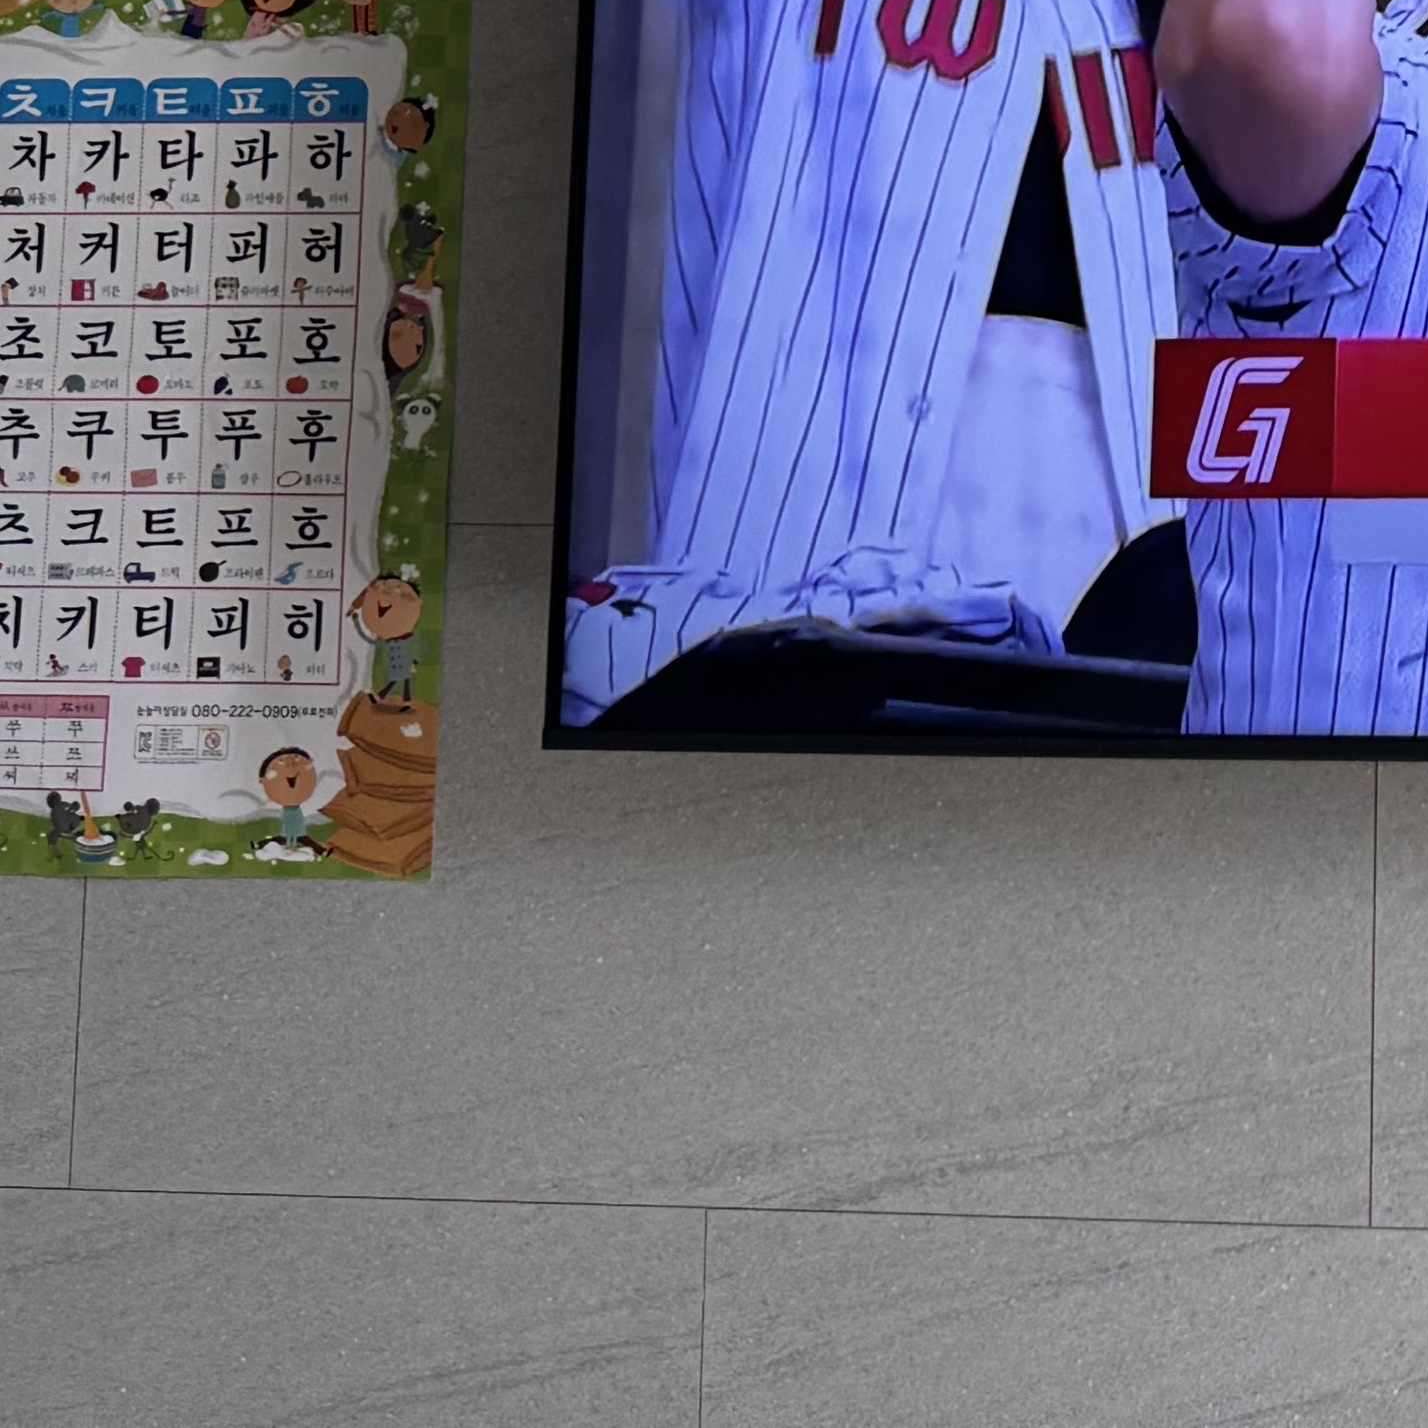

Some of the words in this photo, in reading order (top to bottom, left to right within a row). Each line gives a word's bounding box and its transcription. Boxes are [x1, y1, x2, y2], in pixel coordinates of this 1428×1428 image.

[9, 130, 56, 182] 차
[84, 130, 130, 182] 카
[158, 130, 204, 182] 타
[230, 129, 279, 181] 파
[307, 129, 352, 181] 하
[4, 222, 45, 274] 처
[79, 222, 119, 274] 커
[154, 222, 194, 274] 터
[226, 222, 268, 274] 퍼
[301, 222, 342, 274] 허
[0, 316, 44, 361] 초
[71, 321, 118, 360] 코
[145, 320, 192, 361] 토
[220, 317, 268, 360] 포
[293, 317, 341, 364] 호
[0, 408, 40, 460] 추
[67, 410, 114, 461] 쿠
[141, 409, 189, 461] 투
[215, 409, 262, 461] 푸
[289, 409, 338, 463] 후
[0, 503, 34, 545] 츠
[60, 508, 109, 546] 크
[136, 508, 184, 548] 트
[211, 507, 259, 548] 프
[285, 506, 333, 550] 흐
[0, 595, 23, 649] 치
[56, 596, 98, 650] 키
[133, 596, 174, 651] 티
[207, 597, 249, 651] 피
[283, 598, 323, 652] 히
